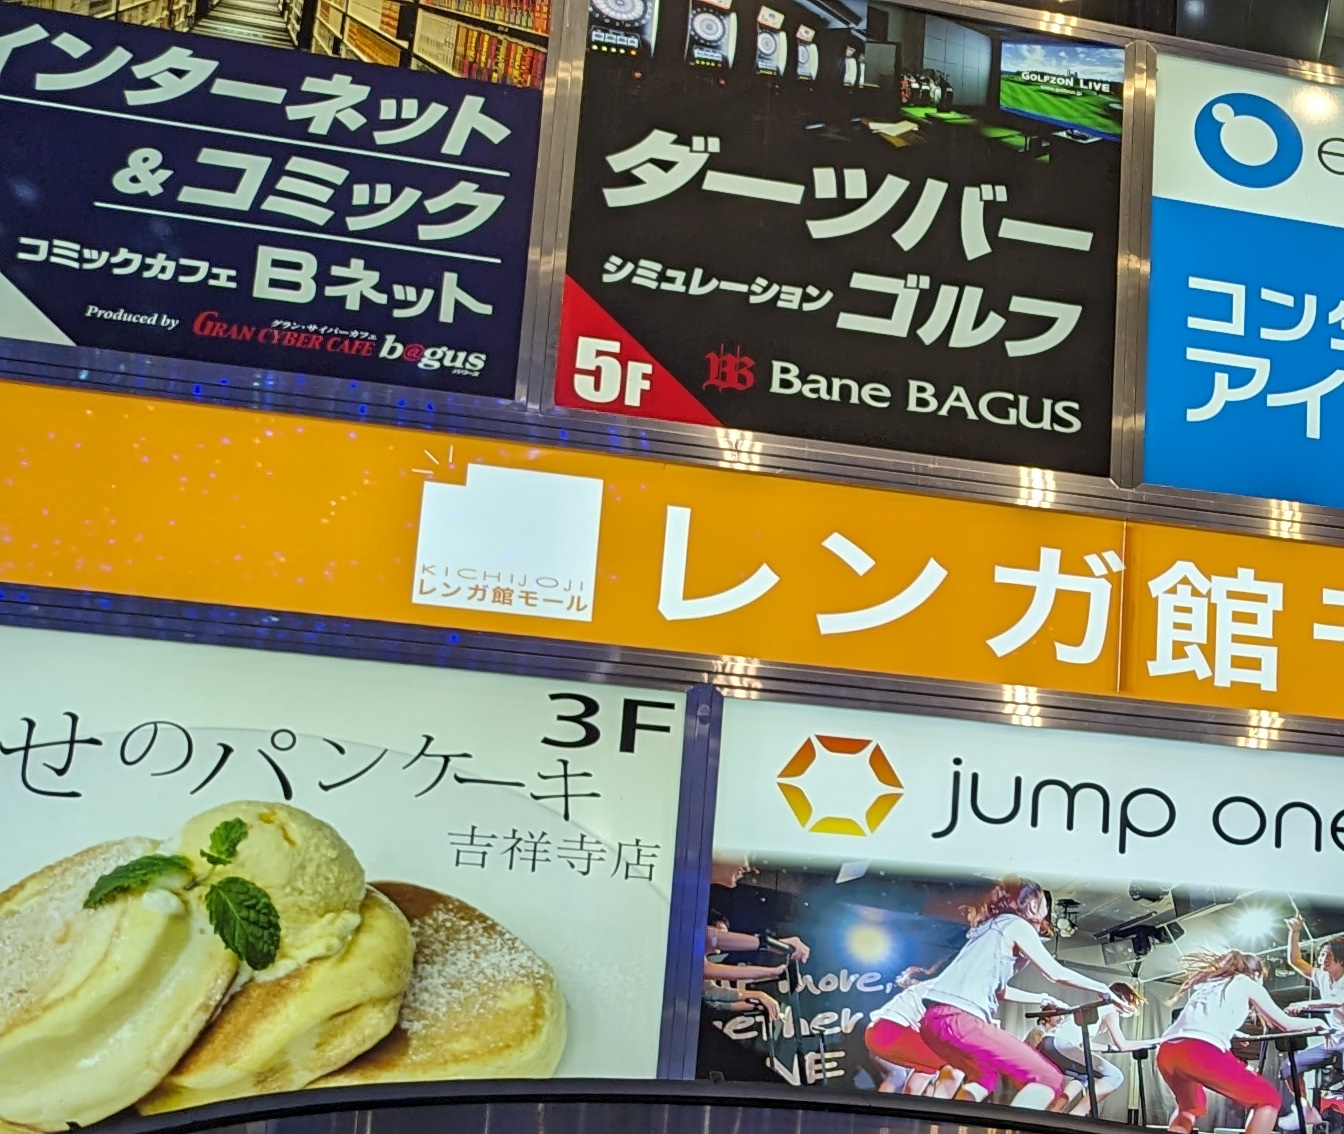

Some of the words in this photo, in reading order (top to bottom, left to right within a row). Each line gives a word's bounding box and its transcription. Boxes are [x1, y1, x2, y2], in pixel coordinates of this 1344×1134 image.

[0, 23, 511, 156] インターネット
[1022, 71, 1074, 88] GOLFZON
[1079, 79, 1111, 93] LIVE
[112, 147, 505, 241] &コミック
[602, 129, 1093, 261] ダーツバー
[17, 237, 237, 289] コミックカフェ
[253, 244, 493, 324] Bネット
[602, 255, 834, 311] シミュレーション
[836, 272, 1083, 358] ゴルフ
[86, 304, 157, 328] Produced
[160, 313, 180, 332] by
[192, 311, 256, 341] GRAN
[257, 327, 324, 350] CYBER
[573, 336, 653, 406] 5F
[769, 361, 892, 408] Bane
[906, 380, 1083, 433] BAGUS
[416, 578, 590, 614] レンガ館モール
[421, 563, 585, 592] KICHIJOJI
[540, 692, 676, 754] 3F
[0, 711, 602, 821] せのパンケーキ
[931, 757, 1176, 854] jump
[448, 825, 662, 882] 吉祥寺店
